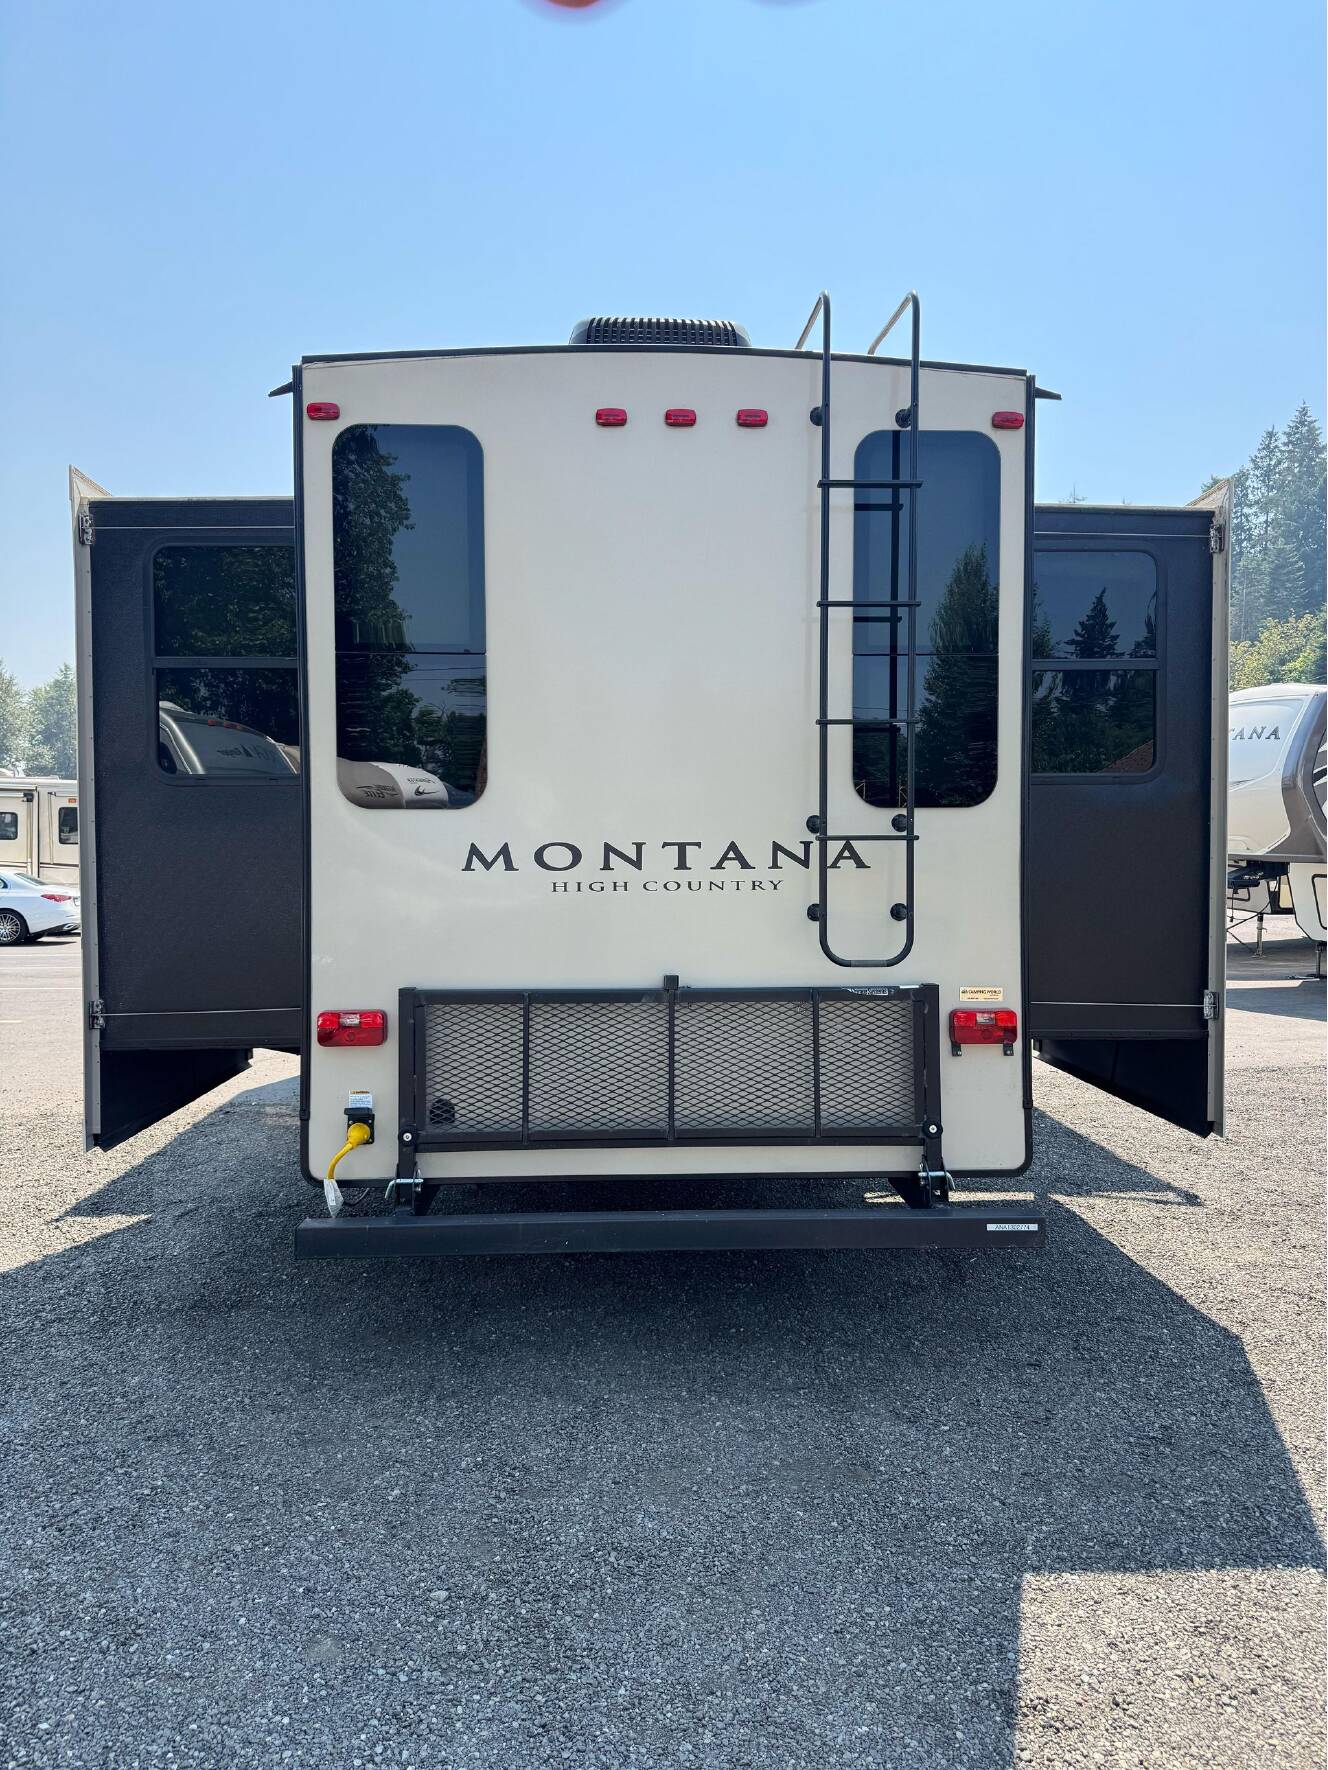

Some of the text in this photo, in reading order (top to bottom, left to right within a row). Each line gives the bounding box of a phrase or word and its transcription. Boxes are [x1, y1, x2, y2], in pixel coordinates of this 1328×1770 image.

[1230, 726, 1281, 740] ANA
[461, 840, 871, 871] MONTANA
[551, 879, 784, 893] HIGH COUNTRY
